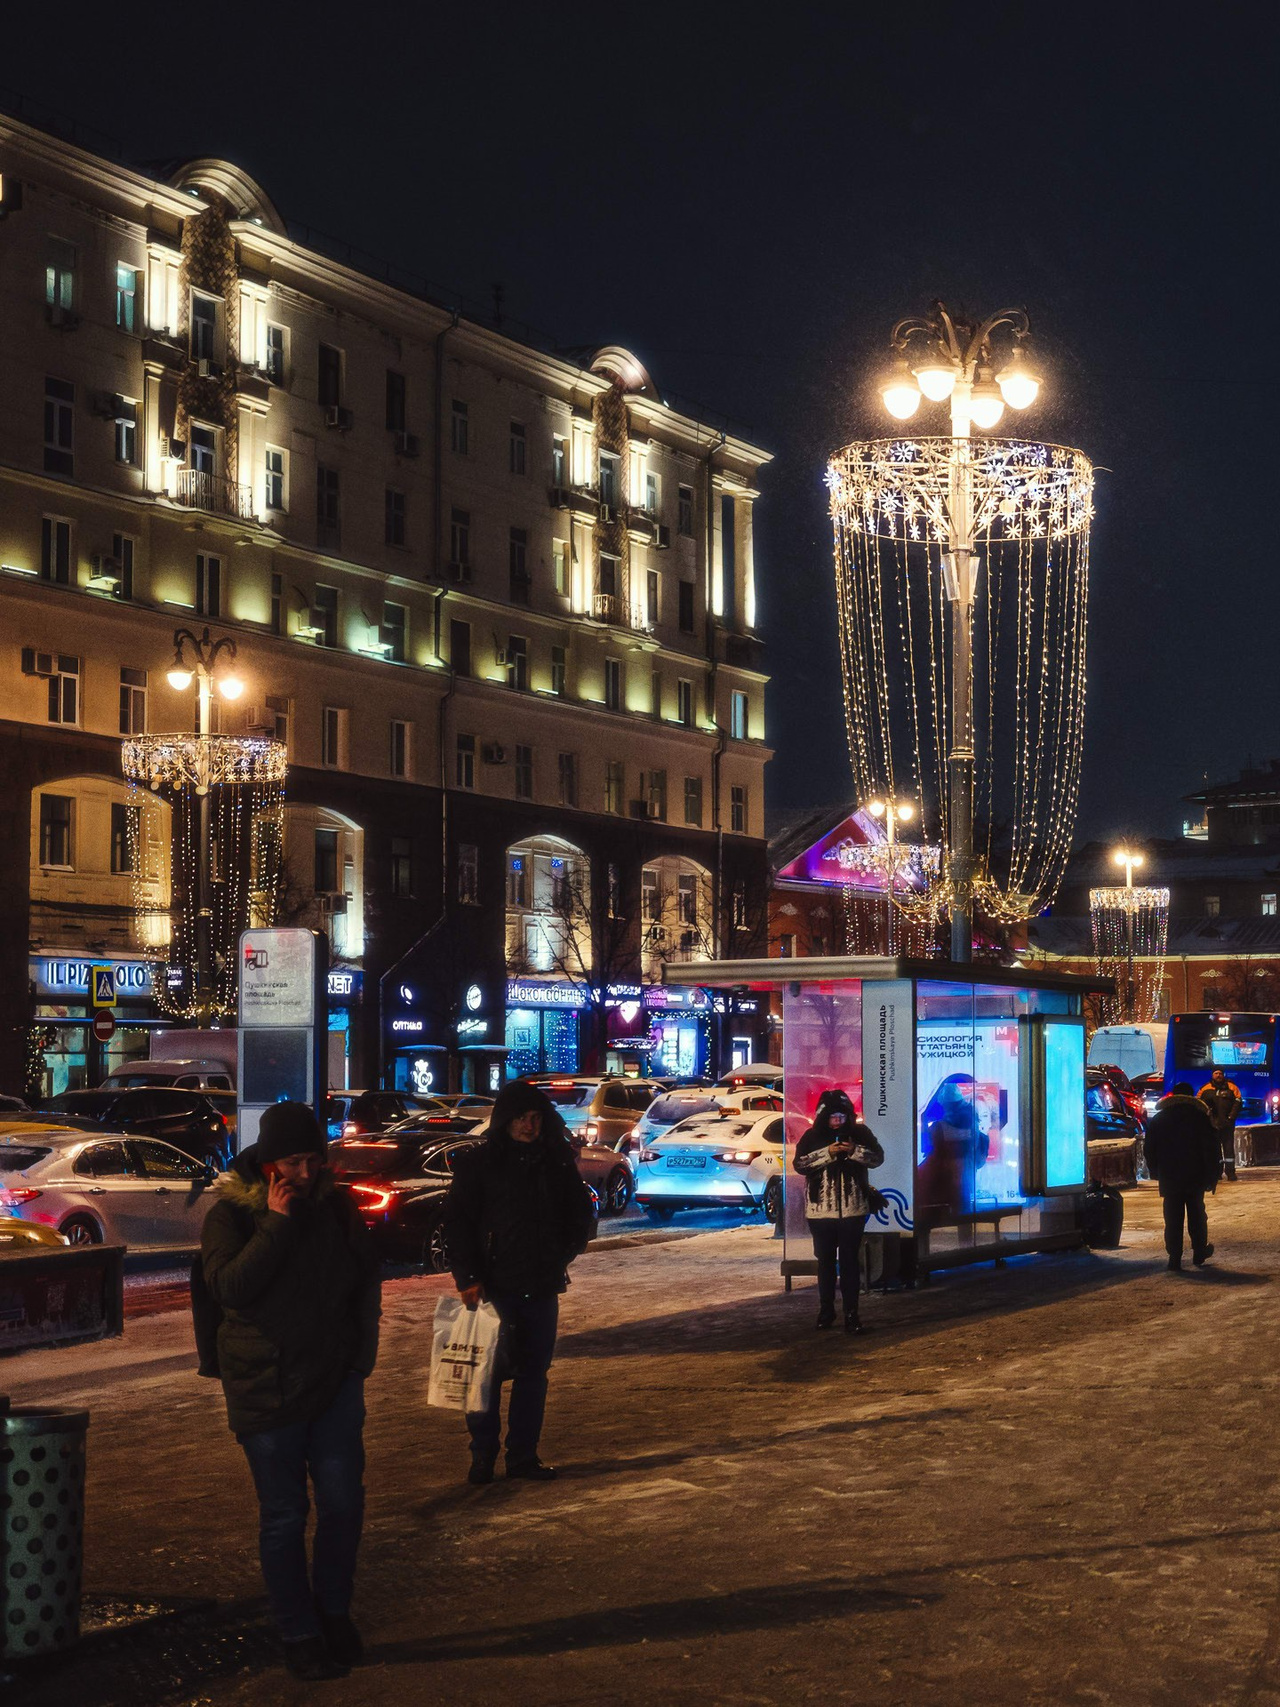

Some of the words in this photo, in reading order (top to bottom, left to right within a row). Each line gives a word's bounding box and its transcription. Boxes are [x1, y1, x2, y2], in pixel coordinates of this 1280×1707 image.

[47, 962, 64, 985] IL
[879, 1004, 887, 1051] площадь
[917, 1035, 983, 1043] СИХОЛОГИЯ
[918, 1050, 975, 1058] УЖИЦКОЙ
[878, 1053, 888, 1117] Пушкинская
